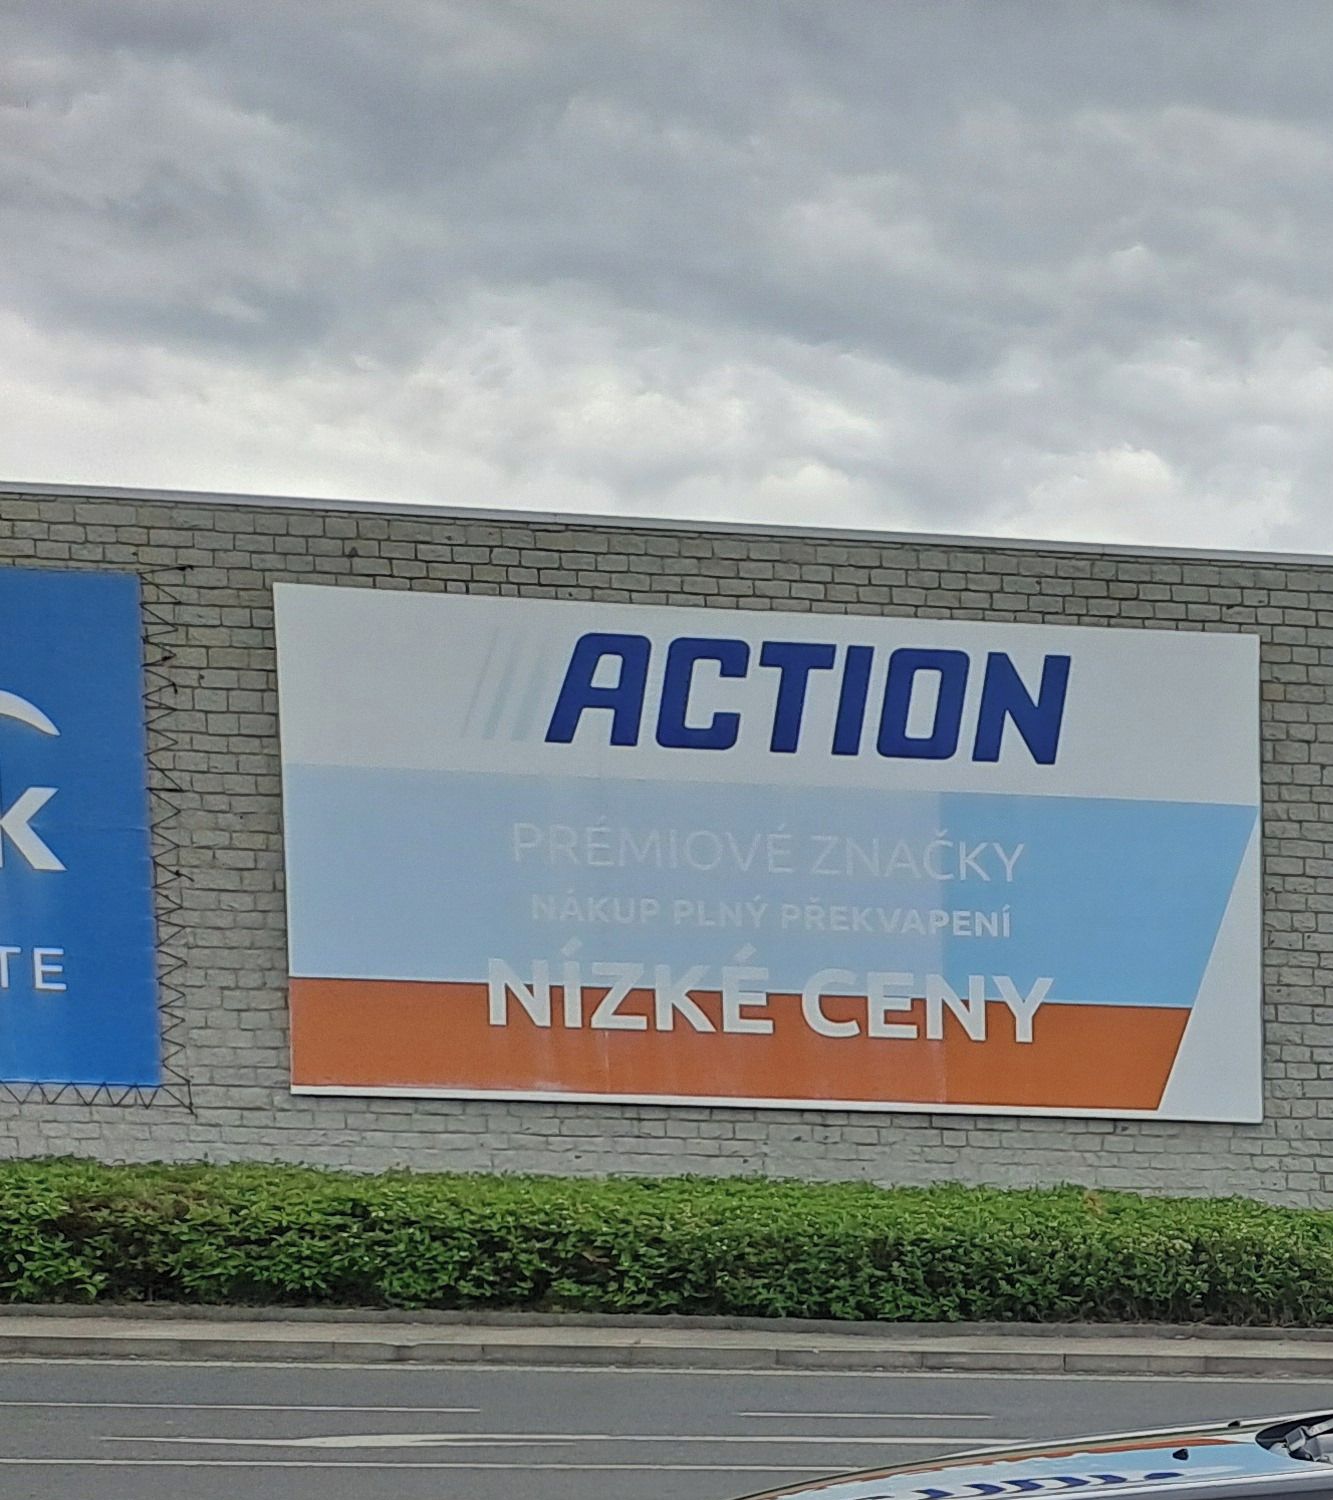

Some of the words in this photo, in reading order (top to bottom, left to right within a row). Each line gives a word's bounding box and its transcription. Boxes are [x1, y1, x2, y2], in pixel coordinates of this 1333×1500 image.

[545, 632, 1071, 765] ACTION
[512, 816, 794, 875] PRÉMIOVÉ
[810, 829, 1025, 883] ZNAČKY
[531, 883, 661, 925] NÁKUP
[675, 893, 768, 929] PLNÝ
[781, 897, 1012, 939] PŘEKVAPENÍ
[488, 937, 775, 1035] NÍZKÉ
[801, 968, 1055, 1043] CENY
